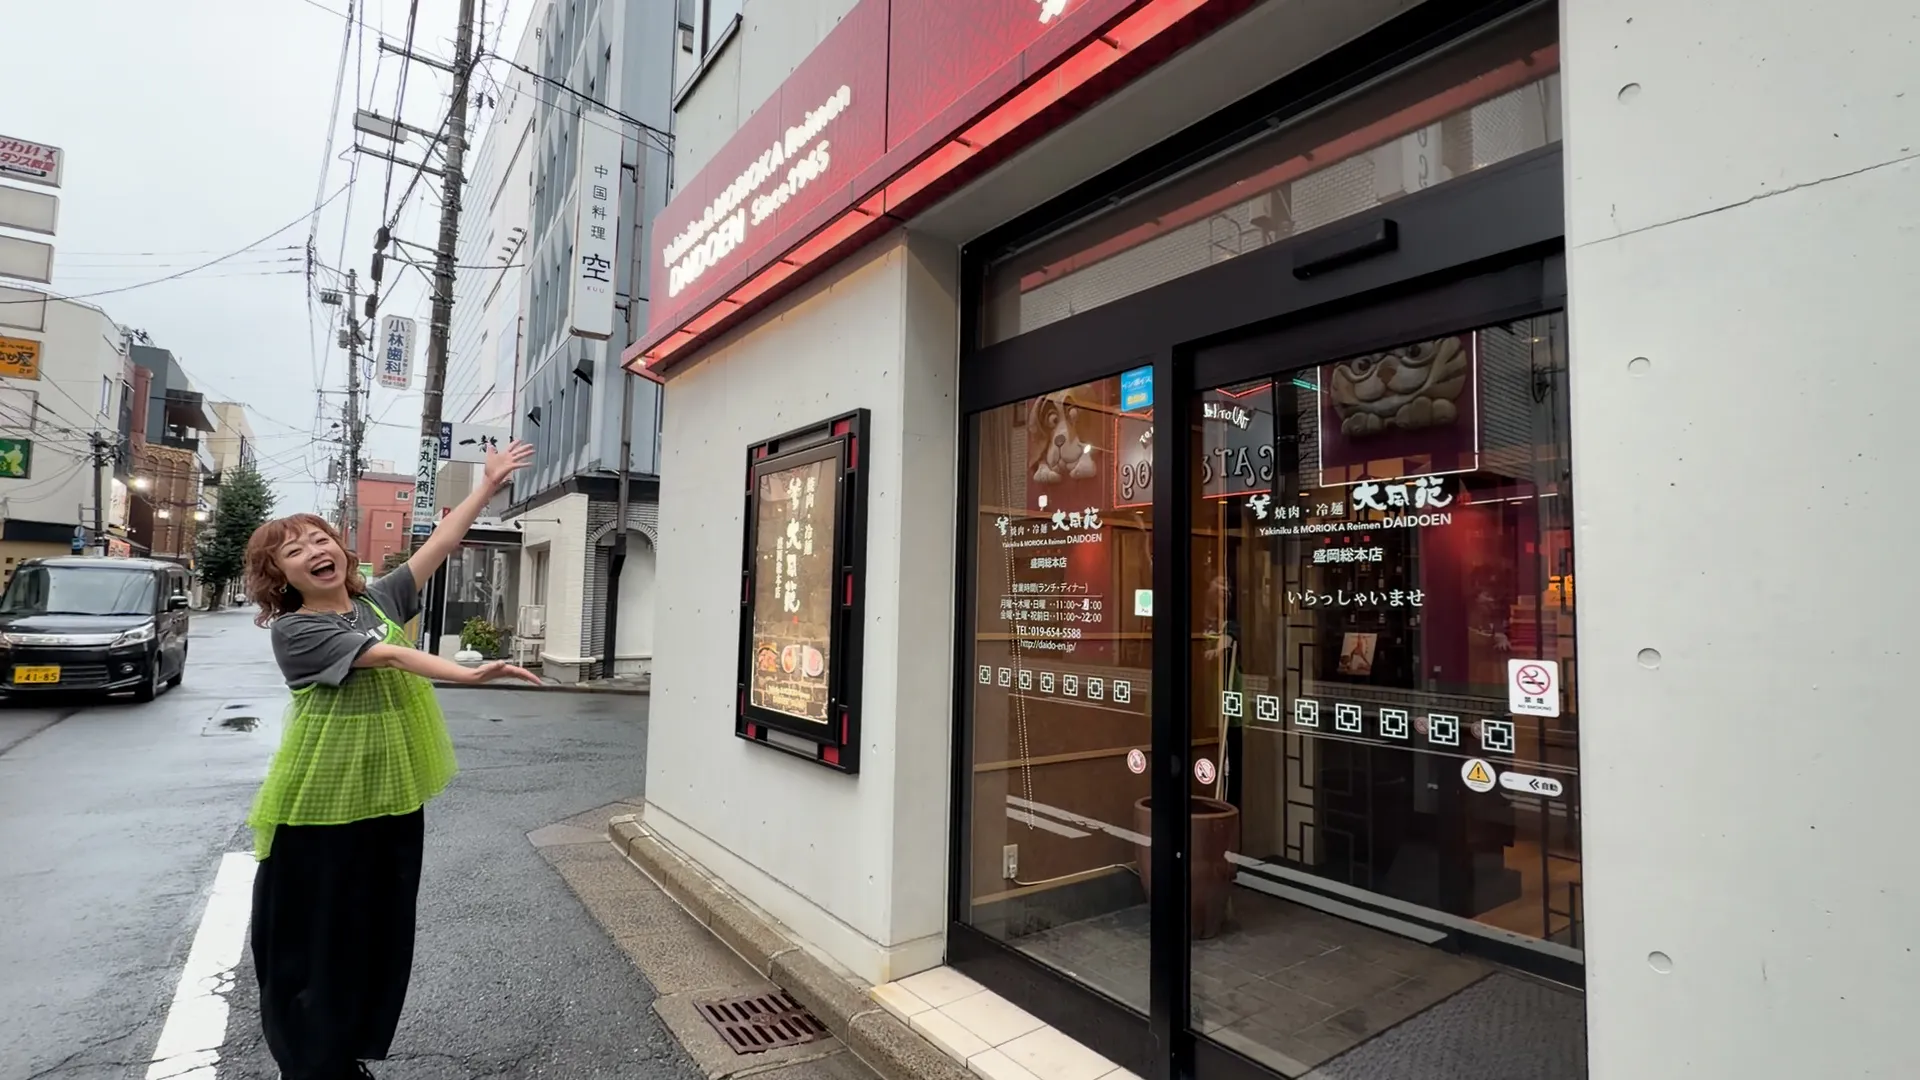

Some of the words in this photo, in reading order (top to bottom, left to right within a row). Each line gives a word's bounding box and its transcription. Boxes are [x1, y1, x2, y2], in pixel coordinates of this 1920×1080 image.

[591, 165, 608, 240] 中国料理
[669, 207, 746, 298] DAIDOEN
[582, 253, 611, 282] 空
[385, 320, 405, 375] 小林歯科
[1274, 501, 1344, 520] 焼肉・冷麺
[1260, 524, 1291, 536] Yakiniku
[1292, 526, 1299, 534] &
[1300, 522, 1345, 534] MORIOKA
[1347, 520, 1381, 531] Reimen
[1383, 513, 1452, 529] DAIDOEN
[1066, 533, 1103, 544] DAIDOEN
[1030, 557, 1067, 569] 盛岡総本店
[1313, 547, 1383, 563] 盛岡総本店
[1288, 589, 1425, 607] いらっしゃいませ
[1541, 782, 1559, 792] 自動
